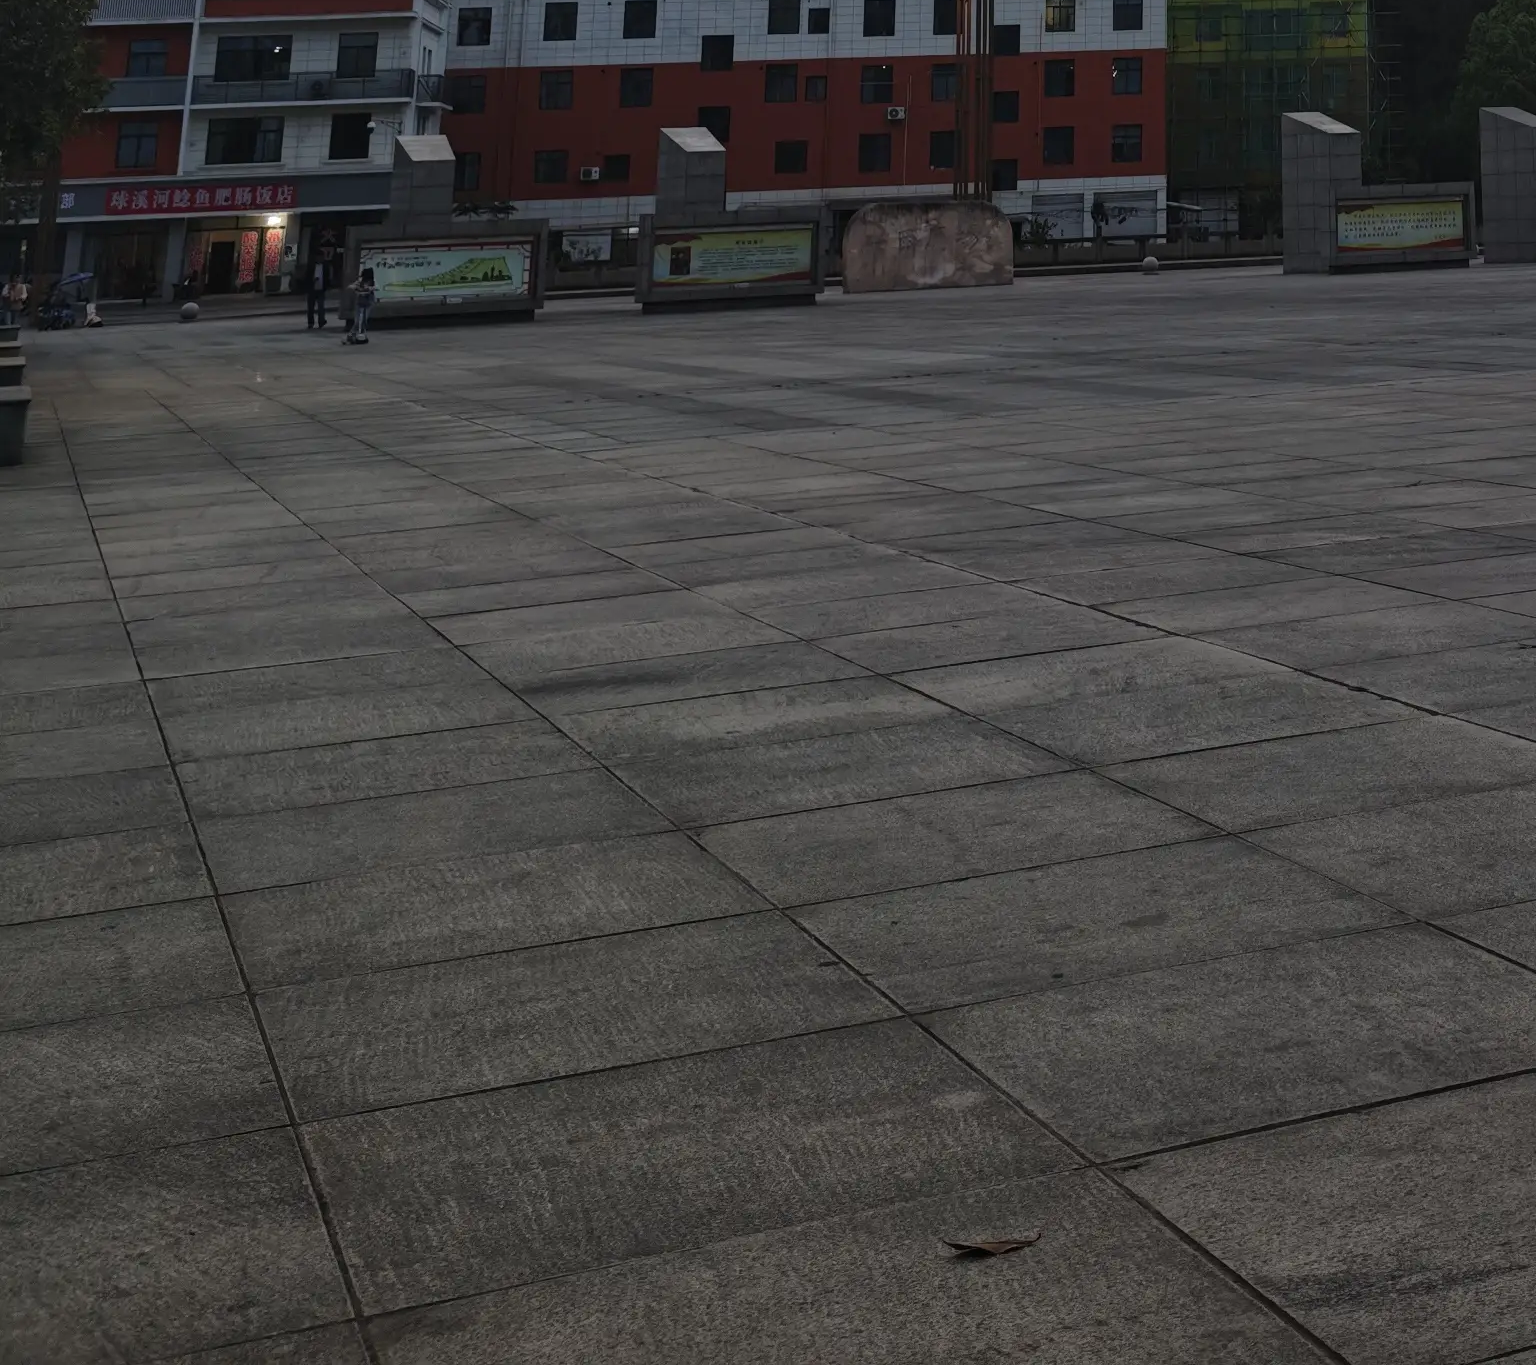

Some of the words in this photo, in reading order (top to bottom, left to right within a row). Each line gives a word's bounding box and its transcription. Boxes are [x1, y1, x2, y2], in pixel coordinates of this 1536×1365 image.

[110, 185, 293, 210] 球溪河鲶鱼肥肠饭店
